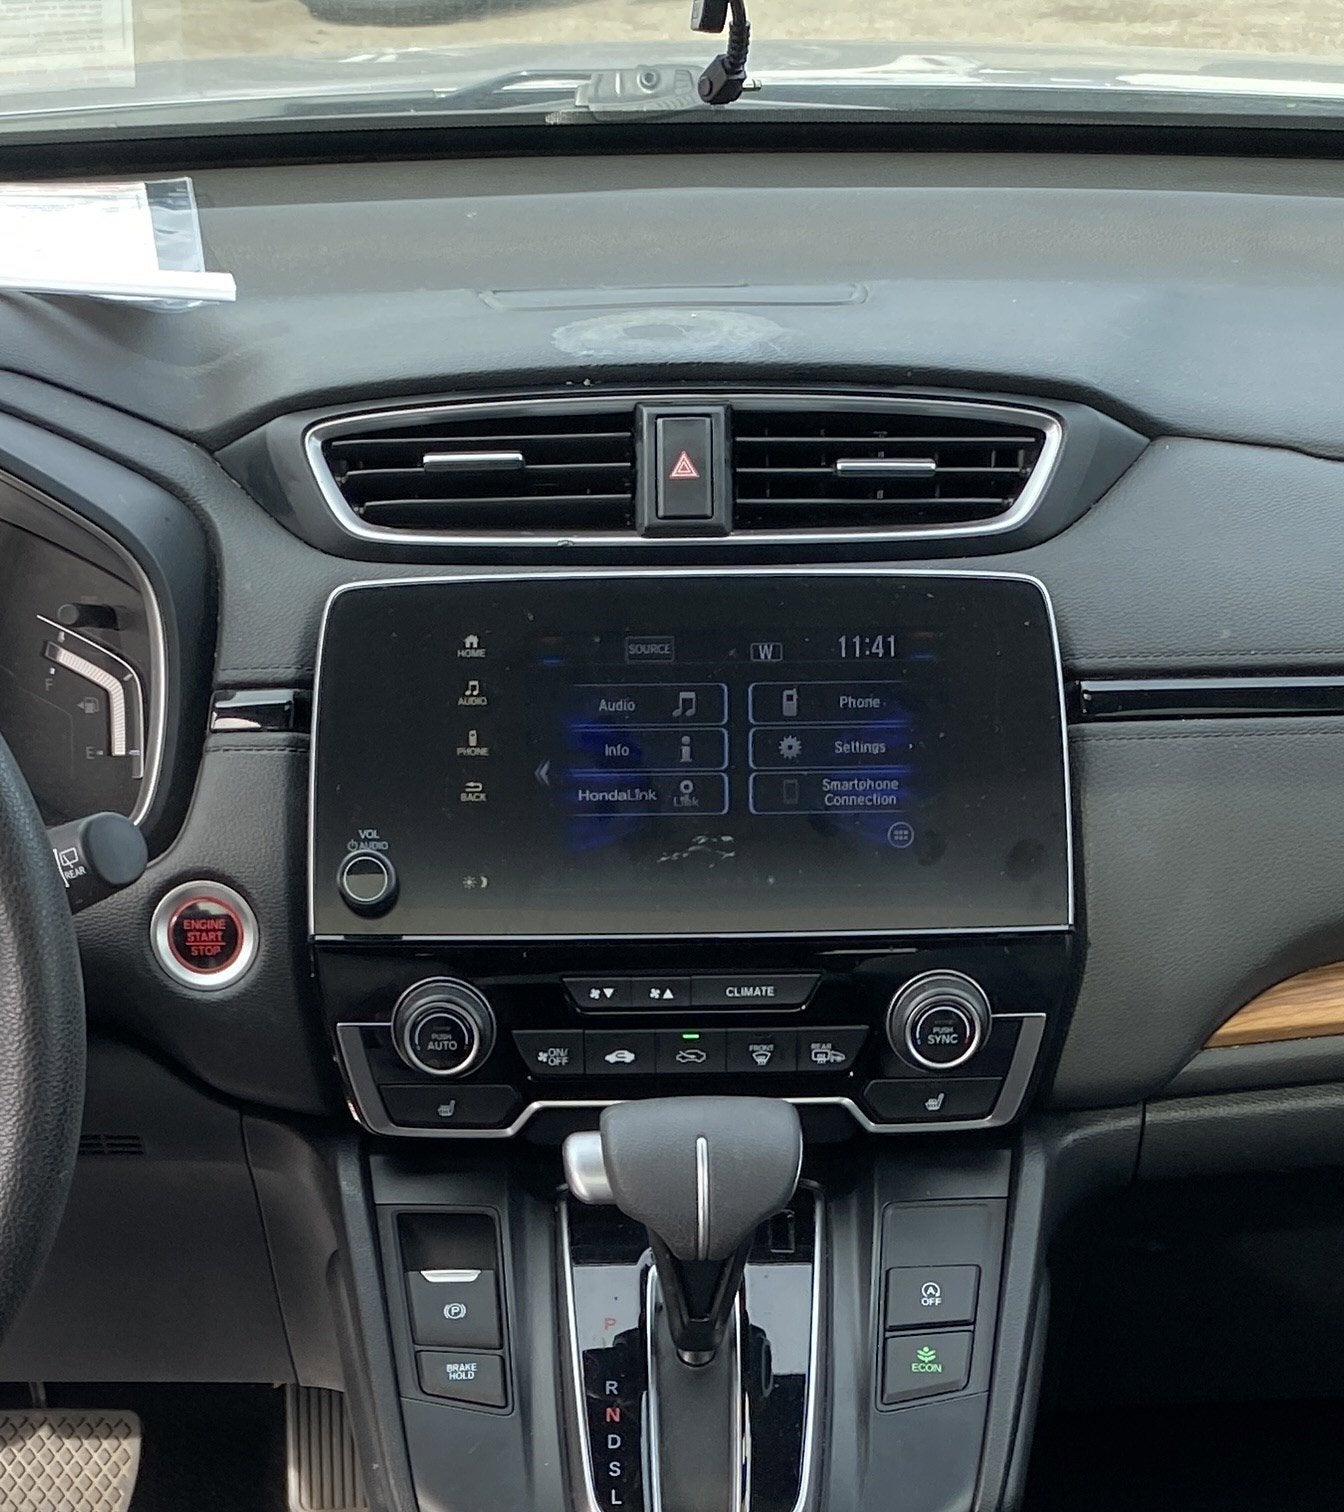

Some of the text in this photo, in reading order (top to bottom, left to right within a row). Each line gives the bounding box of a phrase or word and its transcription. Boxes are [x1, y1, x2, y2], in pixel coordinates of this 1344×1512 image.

[628, 643, 671, 655] SOURCE
[837, 634, 896, 658] 11:41
[457, 649, 486, 658] HOME
[457, 697, 488, 706] AUDIO
[598, 698, 636, 712] Audio
[839, 695, 881, 709] Phone
[456, 748, 489, 757] PHONE
[604, 743, 630, 757] Info
[834, 740, 887, 755] Settings
[821, 777, 900, 792] Smartphone
[459, 793, 487, 802] BACK
[577, 788, 657, 802] HondaLink
[823, 793, 898, 807] Connection
[358, 829, 380, 839] VOL
[63, 864, 87, 881] REAR
[183, 919, 226, 930] ENGINE
[187, 931, 223, 942] START
[191, 946, 222, 956] STOP
[726, 986, 775, 997] CLIMATE
[927, 1034, 959, 1044] SYNC
[427, 1041, 458, 1051] AUTO
[548, 1048, 568, 1057] ON/
[548, 1057, 568, 1066] OFF
[920, 1297, 942, 1307] OFF
[446, 1362, 477, 1373] BRAKE
[911, 1362, 942, 1373] ECON
[448, 1370, 475, 1380] HOLD
[605, 1380, 619, 1395] R
[605, 1408, 620, 1422] N
[607, 1434, 621, 1449] D
[609, 1461, 621, 1477] S
[611, 1489, 622, 1505] L
